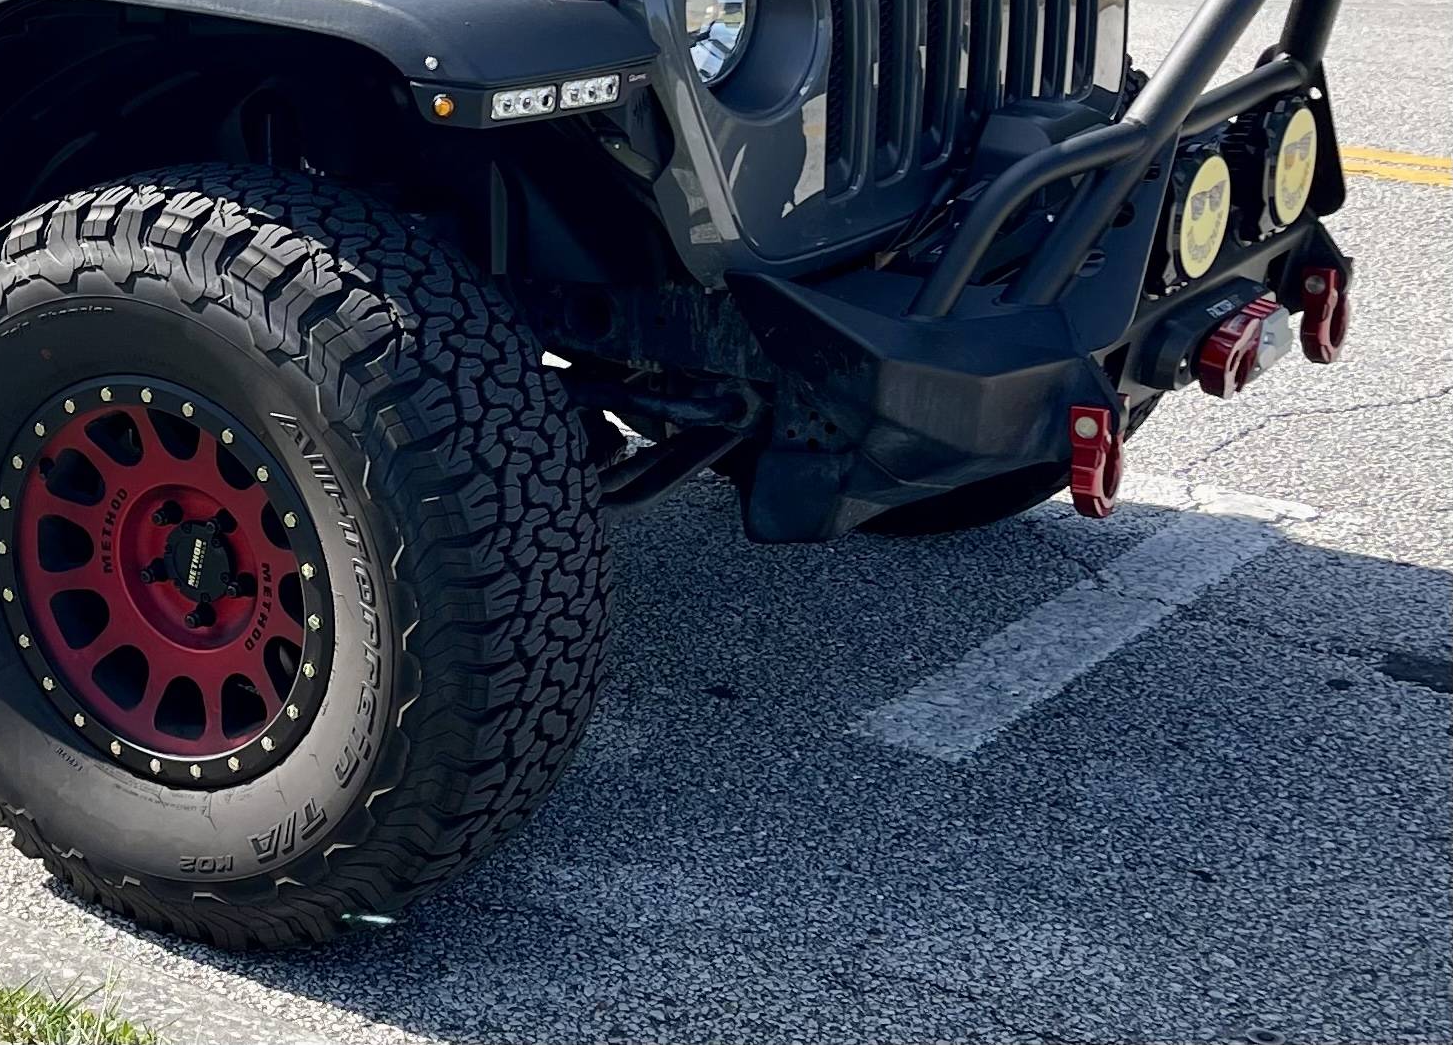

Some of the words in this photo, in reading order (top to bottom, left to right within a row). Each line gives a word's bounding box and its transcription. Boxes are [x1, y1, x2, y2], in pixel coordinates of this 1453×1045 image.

[101, 488, 129, 573] METHOD
[187, 538, 202, 587] METHOD
[244, 562, 273, 651] METHOD
[269, 412, 382, 789] All-Terrain
